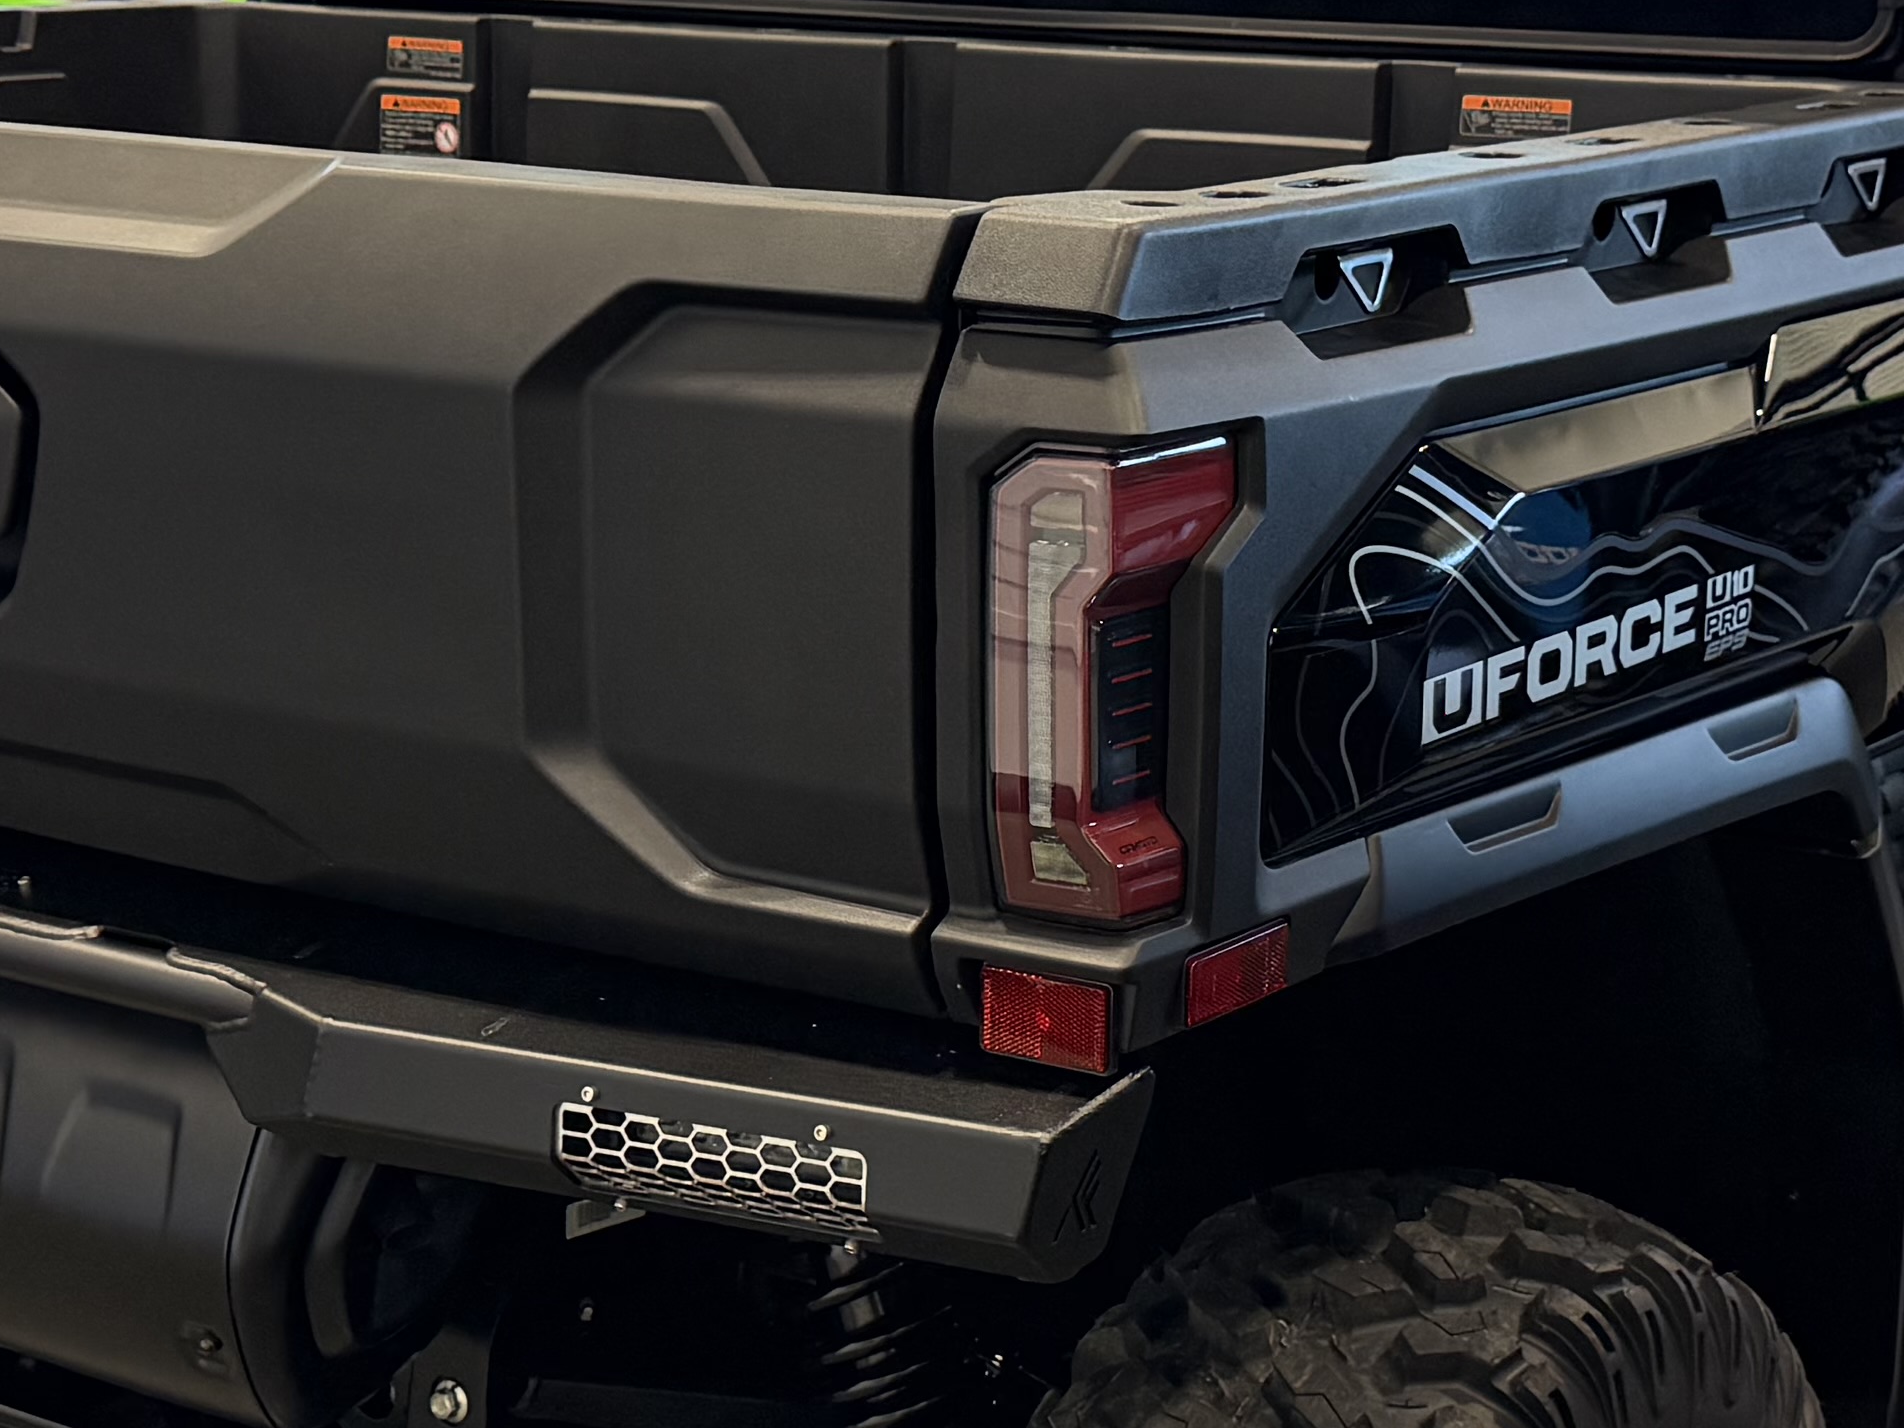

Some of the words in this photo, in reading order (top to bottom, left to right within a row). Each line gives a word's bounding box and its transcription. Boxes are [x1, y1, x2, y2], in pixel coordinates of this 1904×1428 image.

[1492, 98, 1553, 112] WARNING
[1706, 564, 1756, 609] U10
[1704, 598, 1752, 642] PRO
[1421, 584, 1699, 747] UFORCE
[1704, 628, 1750, 662] EPS
